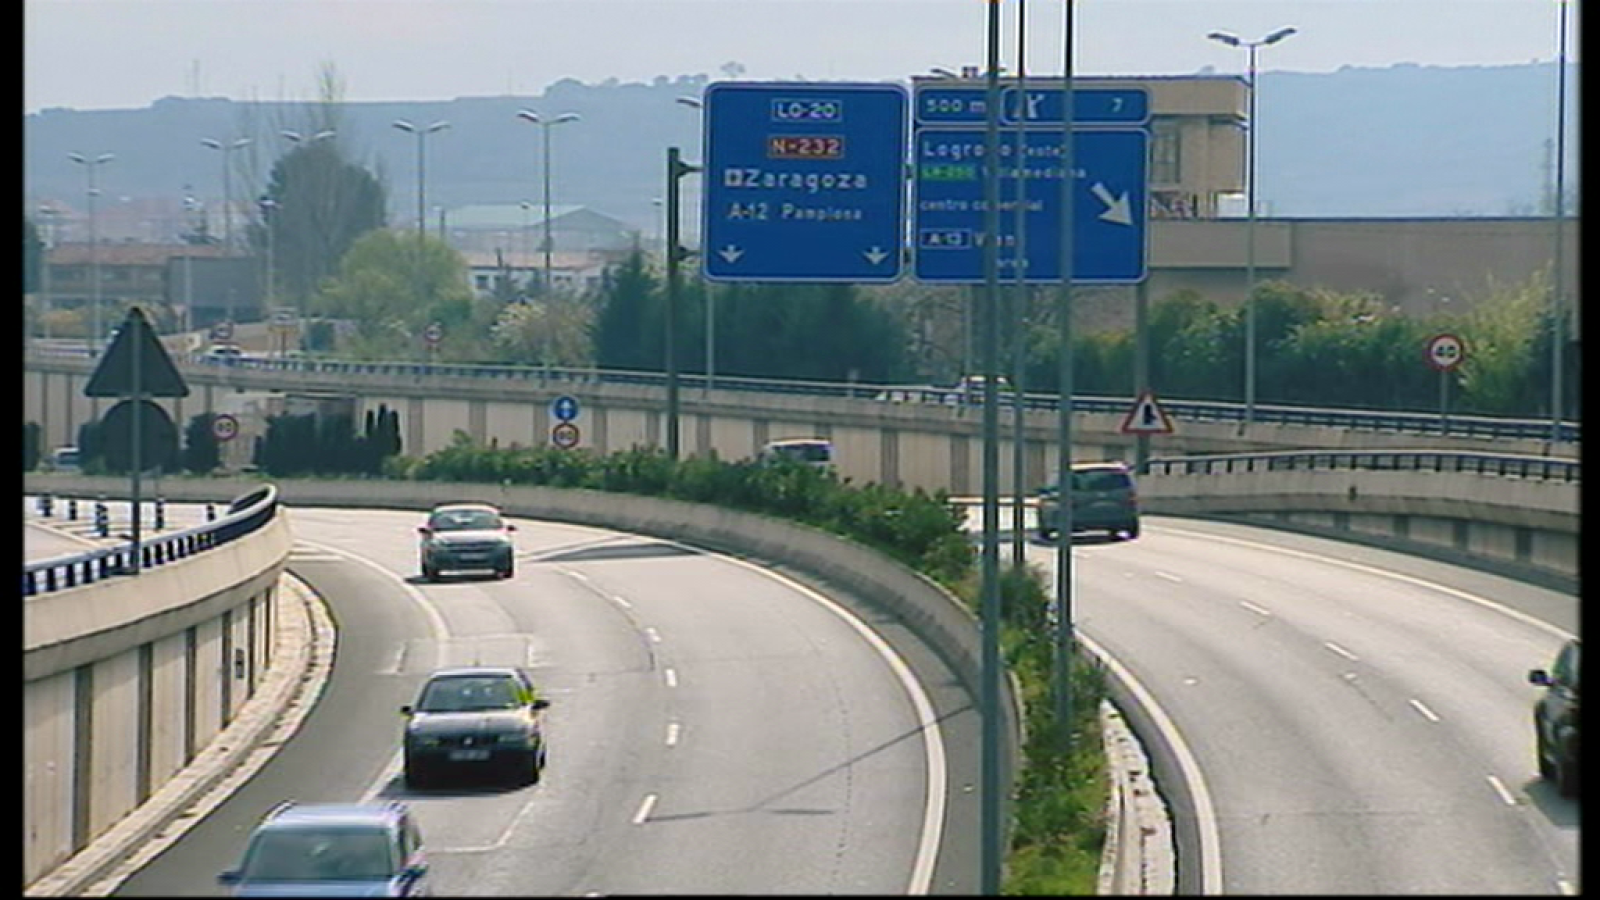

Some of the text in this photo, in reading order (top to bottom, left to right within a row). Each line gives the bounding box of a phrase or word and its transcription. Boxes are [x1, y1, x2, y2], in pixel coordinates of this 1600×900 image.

[777, 102, 836, 118] LO-20
[926, 98, 987, 112] 500 m
[1112, 98, 1123, 112] 7
[771, 138, 840, 155] N-232
[923, 141, 1012, 161] Logroo
[746, 169, 868, 194] Zaragoza
[728, 203, 862, 221] A-12 Pamplona
[921, 200, 967, 212] centro
